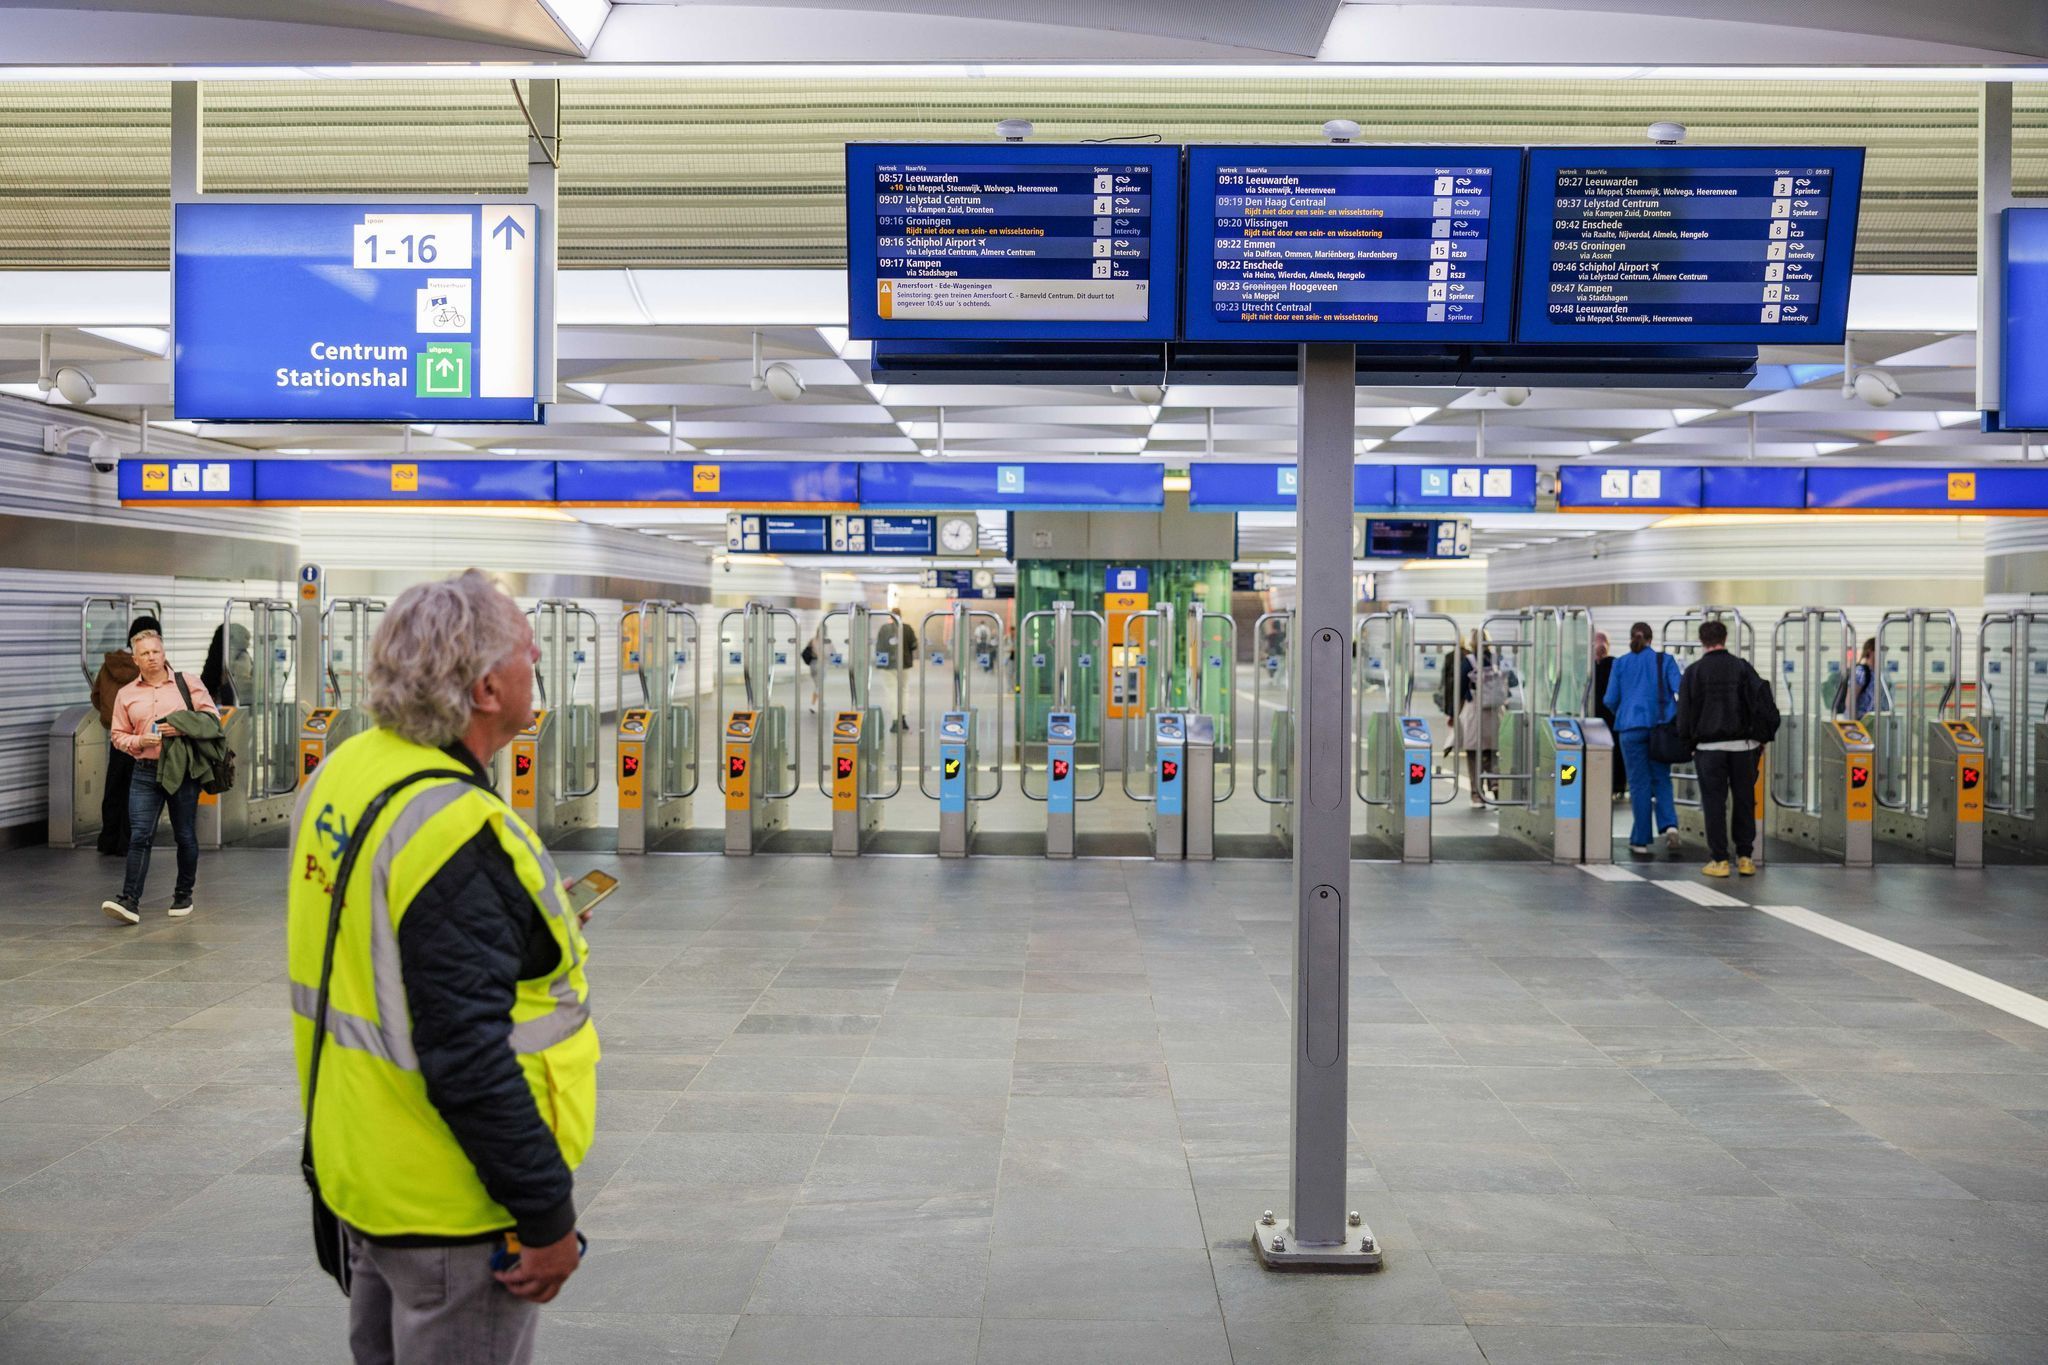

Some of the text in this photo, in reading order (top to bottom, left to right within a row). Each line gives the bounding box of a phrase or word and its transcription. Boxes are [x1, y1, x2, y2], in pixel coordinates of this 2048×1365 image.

[879, 173, 959, 183] 08:57 Leeuwarden
[1219, 175, 1299, 185] 09:18 Leeuwarden
[1558, 177, 1638, 187] 09:27 Leeuwarden
[906, 184, 916, 192] via
[918, 185, 945, 194] Meppel,
[946, 184, 982, 194] Steenwijk,
[984, 185, 1016, 194] Wolvega,
[1017, 185, 1058, 193] Heerenveen
[1100, 181, 1106, 189] 6
[1115, 185, 1141, 193] Sprinter
[1257, 186, 1293, 195] Steenwijk,
[1455, 187, 1482, 195] Intercity
[1597, 188, 1623, 197] Meppel,
[1625, 188, 1661, 197] Steenwijk,
[1663, 188, 1695, 197] Wolvega,
[1696, 188, 1737, 196] Heerenveen
[879, 195, 981, 206] 09:07 Lelystad Centrum
[1218, 197, 1326, 208] 09:19 Den Haag Centraal
[1557, 199, 1659, 210] 09:37 Lelystad Centrum
[918, 206, 946, 215] Kampen
[947, 206, 964, 214] Zuid,
[966, 206, 994, 214] Dronten
[1100, 202, 1106, 211] 4
[1115, 207, 1141, 215] Sprinter
[1245, 208, 1261, 217] Rijdt
[1338, 208, 1384, 217] wisselstoring
[1454, 208, 1481, 216] Intercity
[879, 217, 951, 227] 09:16 Groningen
[1217, 218, 1289, 229] 09:20 Vlissingen
[1555, 220, 1623, 229] 09:42 Enschede
[906, 227, 922, 236] Rijdt
[924, 227, 938, 235] niet
[938, 227, 956, 235] door
[970, 227, 988, 235] sein-
[1000, 227, 1045, 236] wisselstoring
[1114, 228, 1141, 236] Intercity
[1593, 231, 1617, 239] Raalte,
[1619, 231, 1651, 240] Nijverdal,
[1652, 231, 1678, 239] Almelo,
[1680, 231, 1709, 240] Hengelo
[879, 237, 976, 248] 09:16 Schiphol Airport
[1217, 240, 1276, 249] 09:22 Emmen
[1554, 242, 1626, 252] 09:45 Groningen
[906, 248, 916, 256] via
[918, 248, 946, 257] Lelystad
[1100, 244, 1105, 253] 3
[1114, 249, 1141, 257] Intercity
[1435, 247, 1445, 255] 15
[1243, 250, 1398, 260] via Dalfsen, Ommen, Mariënberg, Hardenberg
[880, 259, 942, 269] 09:17 Kampen
[1216, 260, 1284, 270] 09:22 Enschede
[1552, 262, 1649, 273] 09:46 Schiphol Airport
[918, 269, 958, 278] Stadshagen
[1097, 266, 1107, 274] 13
[1243, 271, 1365, 280] via Heino, Wierden, Almelo, Hengelo
[1216, 282, 1338, 293] 09:23 Groningen Hoogeveen
[1551, 284, 1613, 294] 09:47 Kampen
[1242, 292, 1280, 301] via Meppel
[1433, 289, 1442, 297] 14
[1449, 293, 1475, 301] Sprinter
[1215, 302, 1312, 312] 09:23 Utrecht Centraal
[1549, 304, 1628, 313] 09:48 Leeuwarden
[310, 342, 408, 360] Centrum
[429, 346, 452, 354] uitgang
[276, 367, 407, 387] Stationshal
